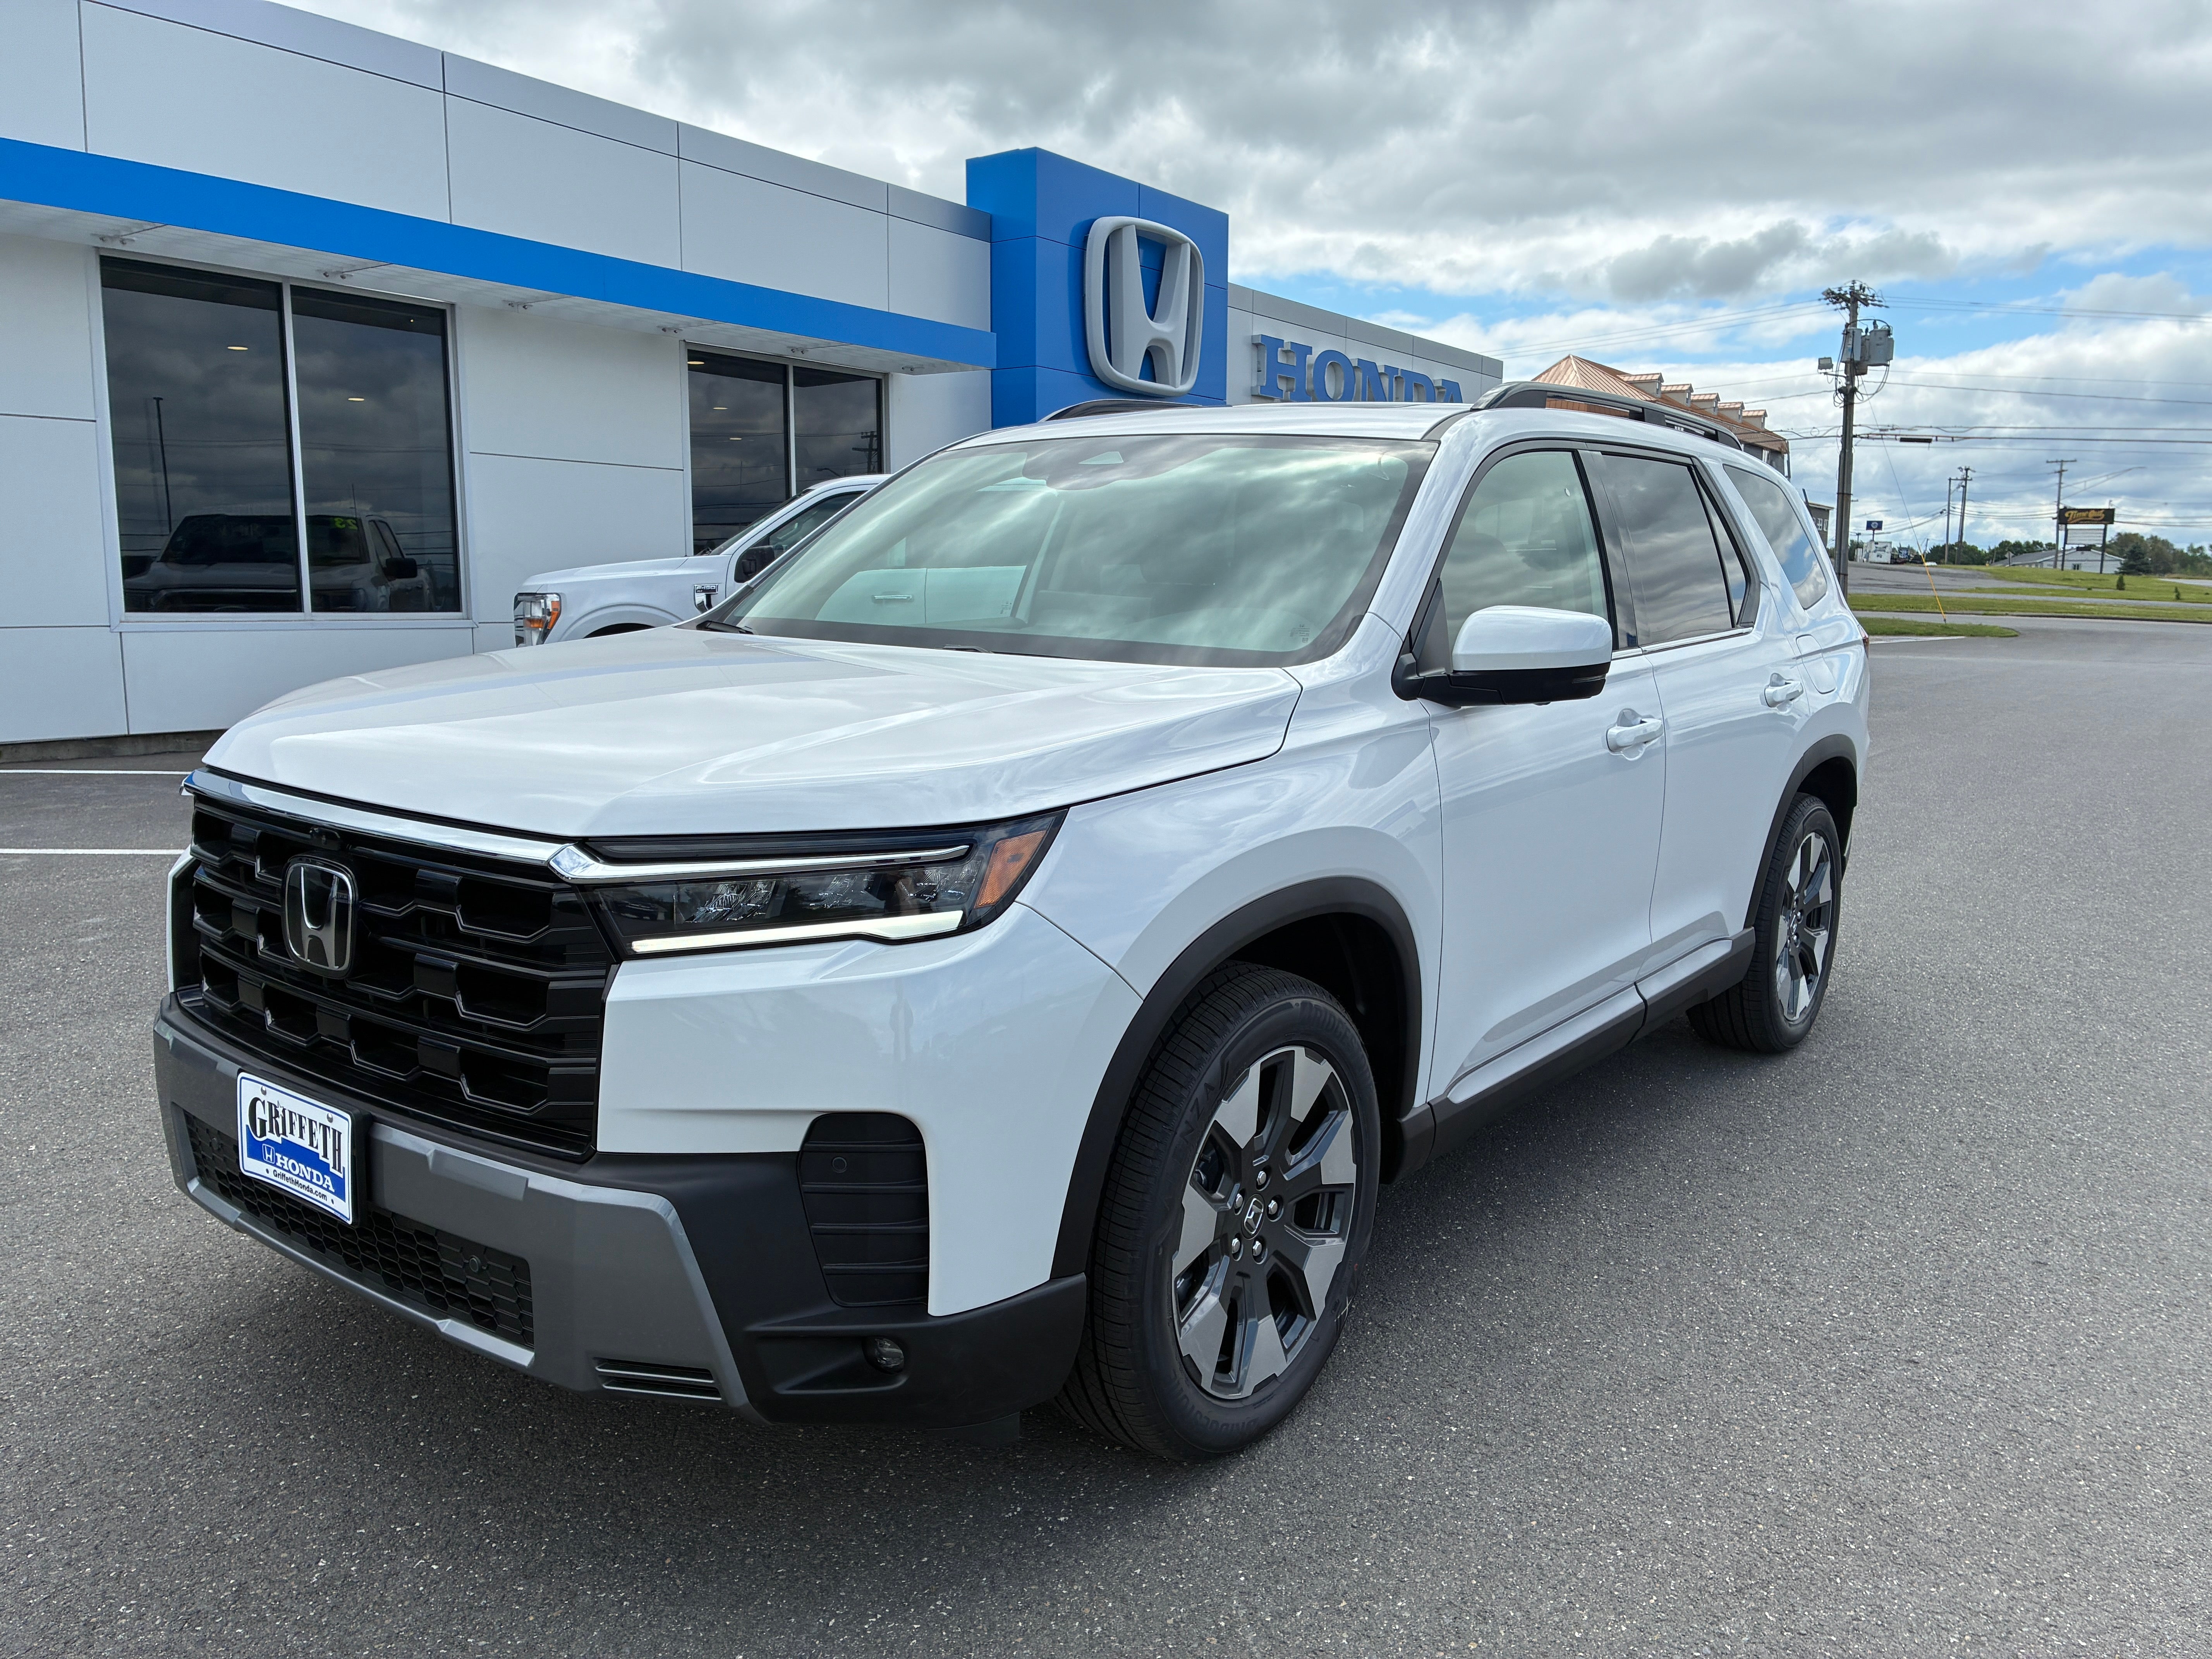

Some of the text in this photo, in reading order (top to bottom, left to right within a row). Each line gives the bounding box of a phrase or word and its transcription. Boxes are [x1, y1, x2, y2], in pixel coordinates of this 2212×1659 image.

[1252, 334, 1463, 403] HONDA
[249, 1097, 342, 1174] GRIFFETH
[273, 1169, 327, 1200] GriffethHonda.com
[275, 1153, 335, 1192] HONDA
